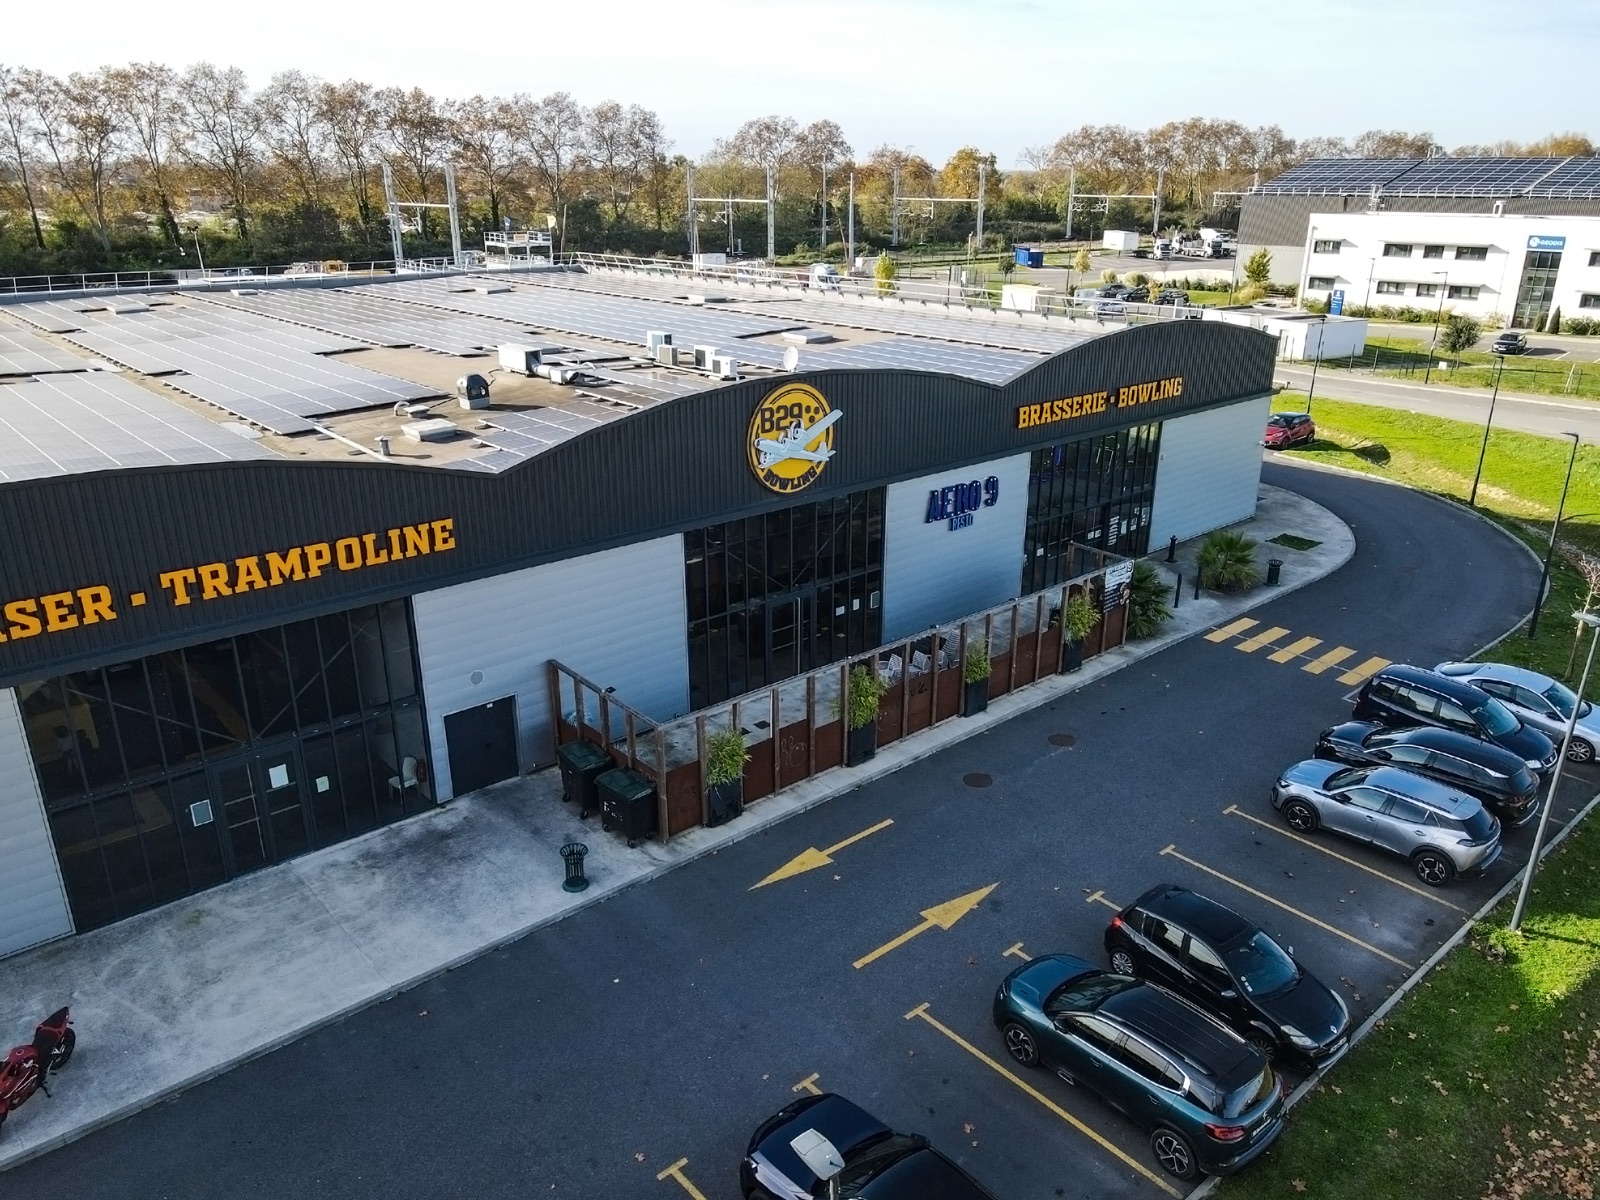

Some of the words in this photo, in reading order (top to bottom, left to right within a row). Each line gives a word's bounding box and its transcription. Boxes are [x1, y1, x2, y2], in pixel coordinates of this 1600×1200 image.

[761, 402, 803, 434] B29
[1018, 391, 1108, 429] BRASSERIE
[1118, 377, 1183, 408] BOWLING
[763, 466, 818, 490] BOWLING
[925, 480, 981, 523] AERO
[984, 476, 999, 507] 9
[950, 513, 974, 531] RESTO
[0, 585, 117, 643] SER
[160, 518, 456, 606] TRAMPOLINE
